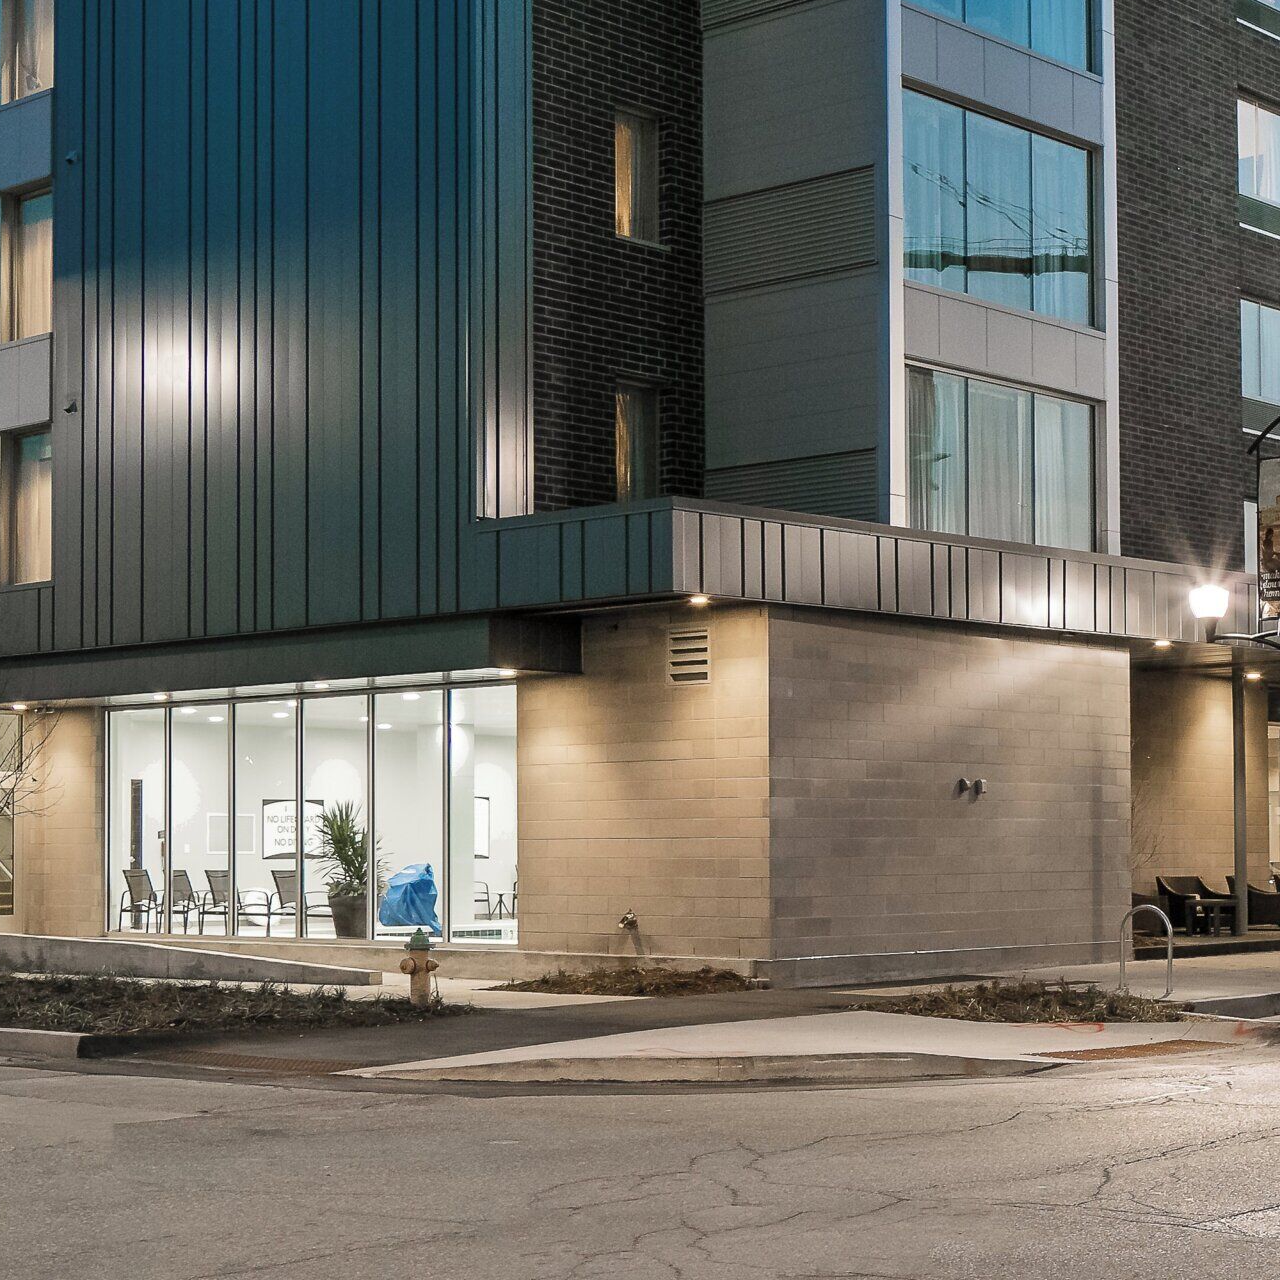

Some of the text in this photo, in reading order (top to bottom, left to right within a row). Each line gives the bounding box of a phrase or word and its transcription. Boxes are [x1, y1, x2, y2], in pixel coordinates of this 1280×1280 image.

[266, 815, 321, 823] NO LIFEARD
[277, 825, 310, 833] ON DY
[274, 838, 286, 846] NO
